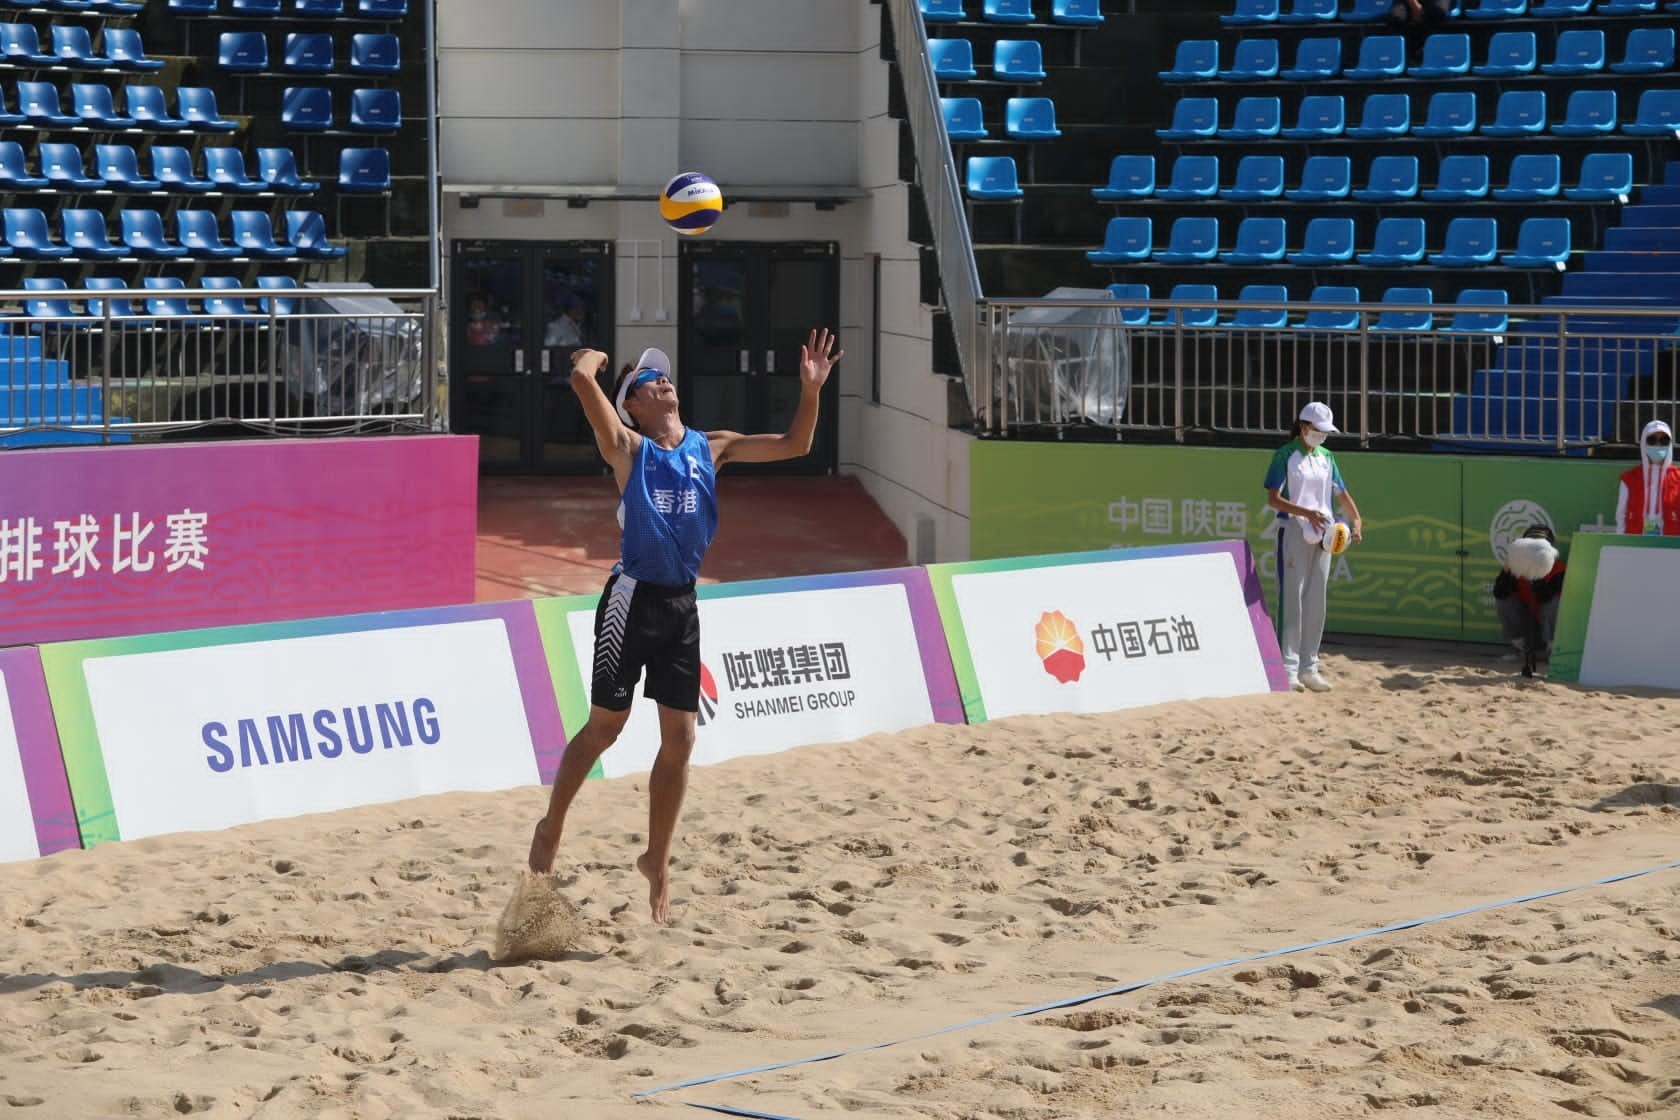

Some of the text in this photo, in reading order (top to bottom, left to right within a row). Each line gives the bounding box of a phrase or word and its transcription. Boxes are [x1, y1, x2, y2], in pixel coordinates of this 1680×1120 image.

[652, 489, 697, 514] 香港
[0, 508, 208, 583] 排球比赛
[1091, 614, 1200, 661] 中国石油
[722, 642, 851, 691] 陕煤集团
[735, 690, 855, 719] SHANMEI GROUP
[201, 697, 440, 773] SAMSUNG
